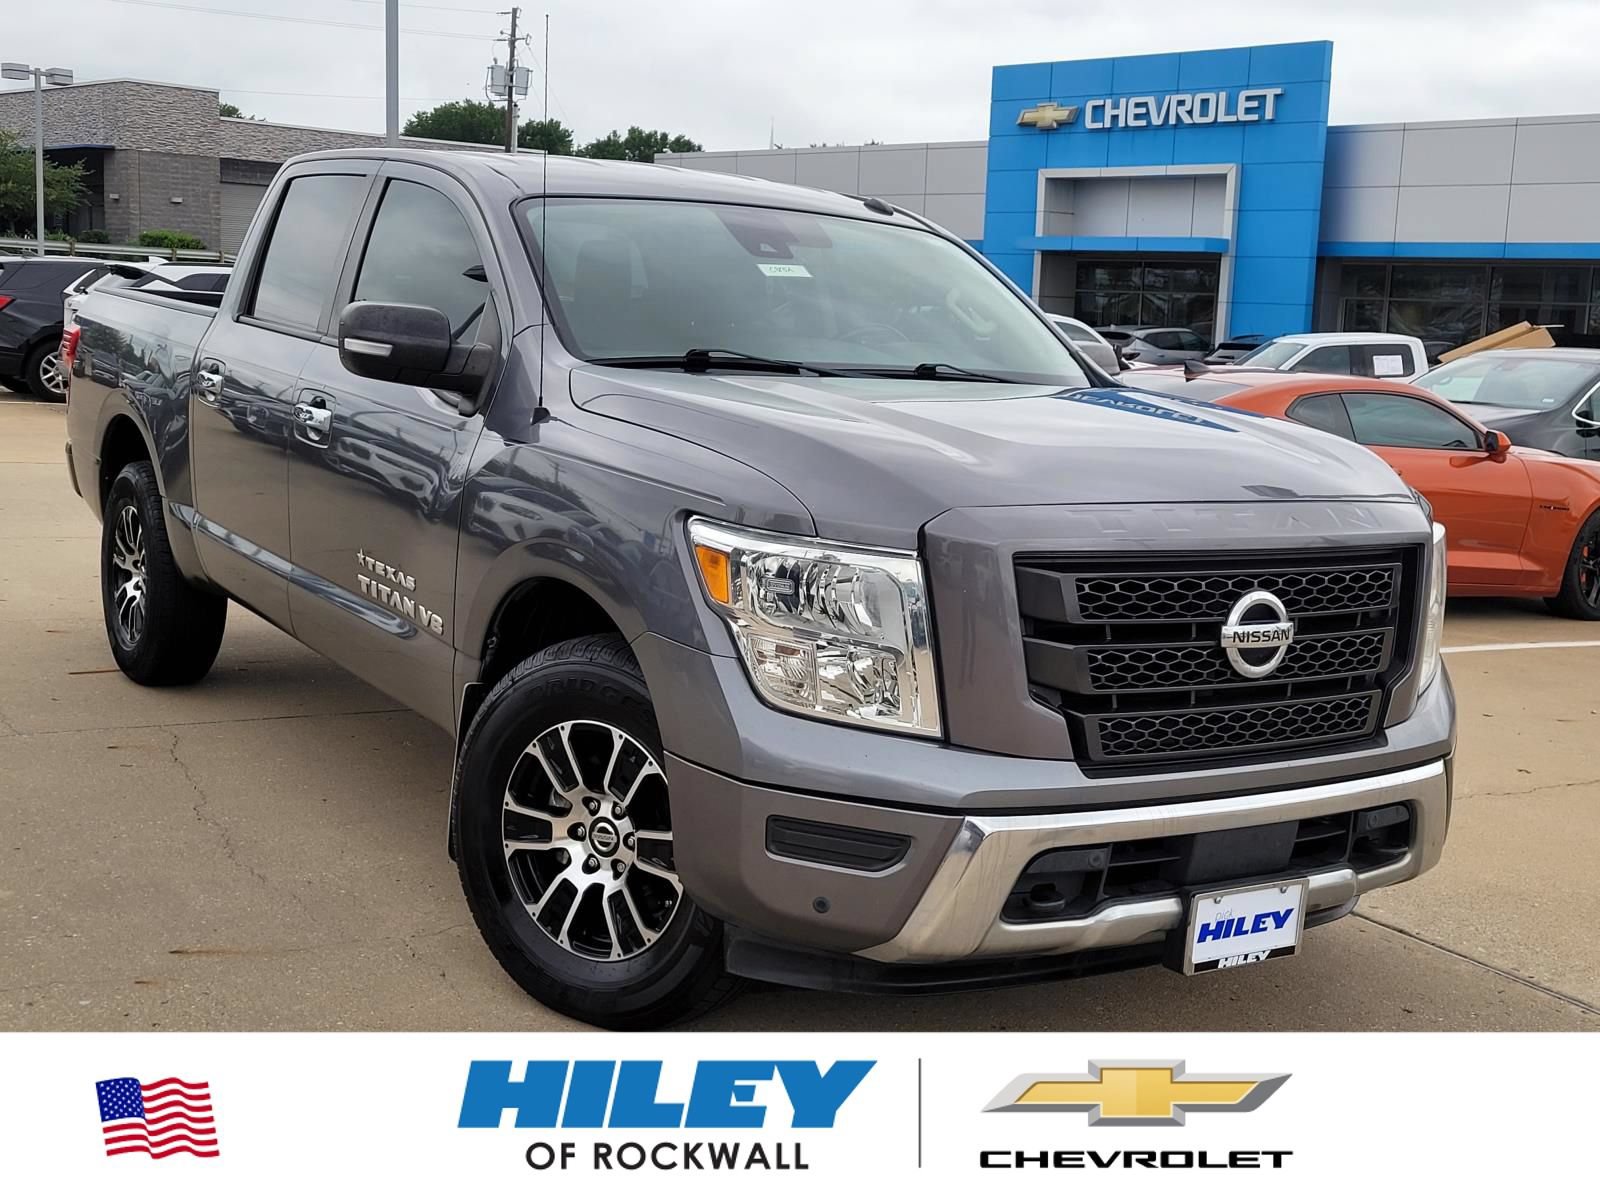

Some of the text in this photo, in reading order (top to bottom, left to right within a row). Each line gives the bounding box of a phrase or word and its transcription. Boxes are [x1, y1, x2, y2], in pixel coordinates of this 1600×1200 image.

[1084, 87, 1284, 130] CHEVROLET
[365, 556, 416, 591] TEXAS
[357, 573, 444, 636] TITAN V8
[1232, 627, 1290, 643] NISSAN
[1196, 907, 1295, 944] HILEY
[1217, 949, 1272, 969] HILEY
